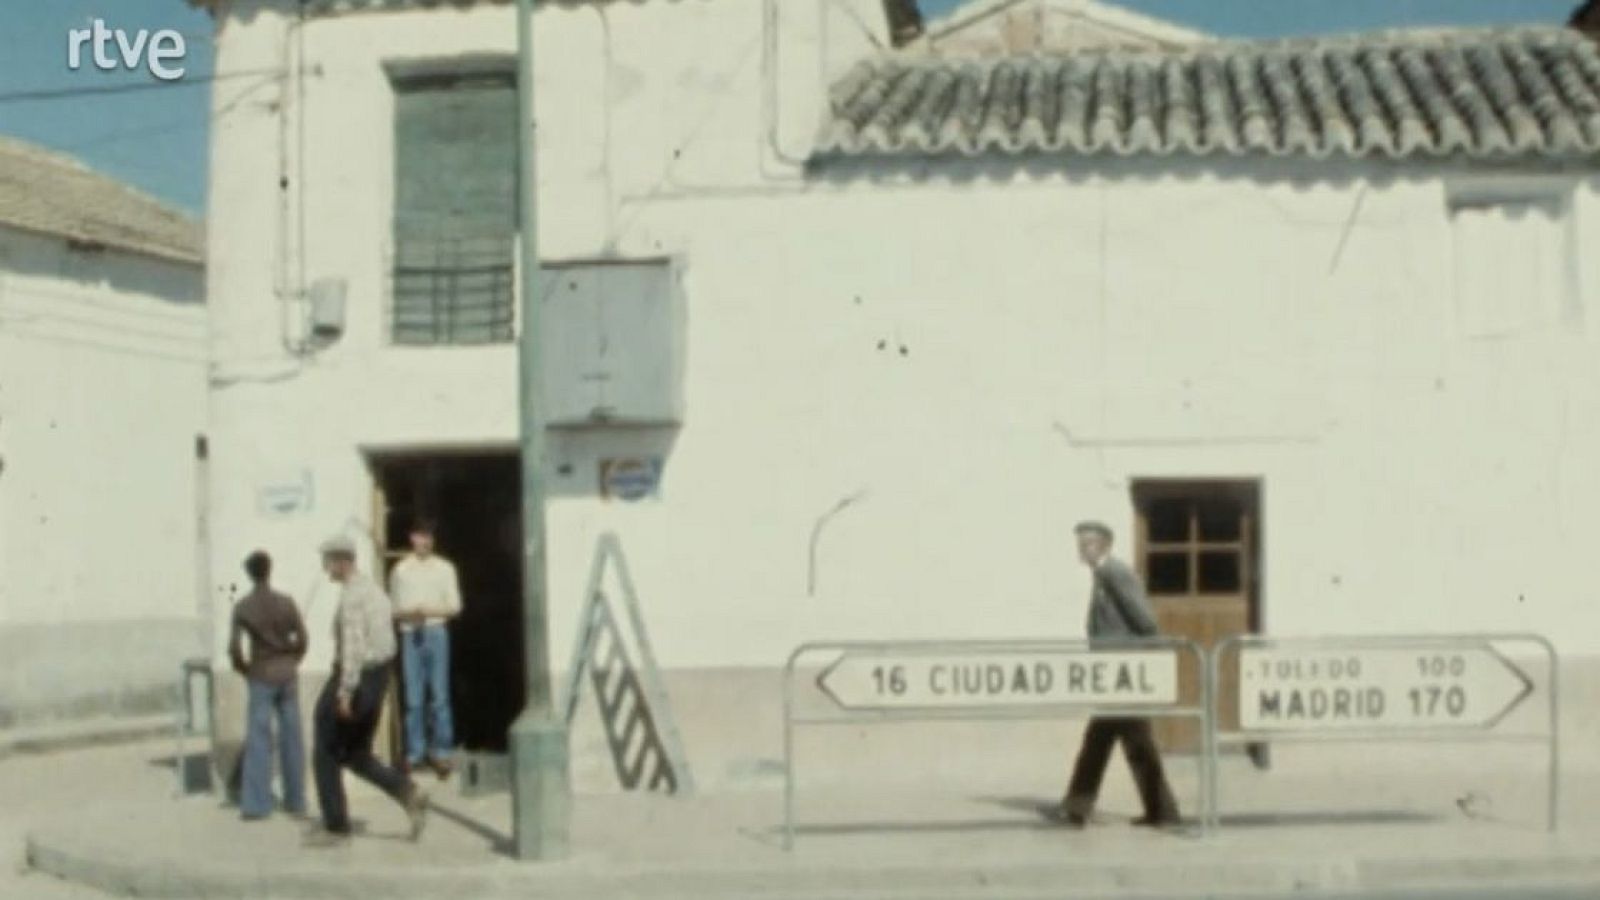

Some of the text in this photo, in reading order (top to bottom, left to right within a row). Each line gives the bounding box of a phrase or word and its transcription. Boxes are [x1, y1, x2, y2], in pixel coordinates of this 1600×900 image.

[871, 661, 1155, 695] 16 CIUDAD REAL
[1417, 655, 1466, 677] 100
[1258, 685, 1467, 719] MADRID 170
